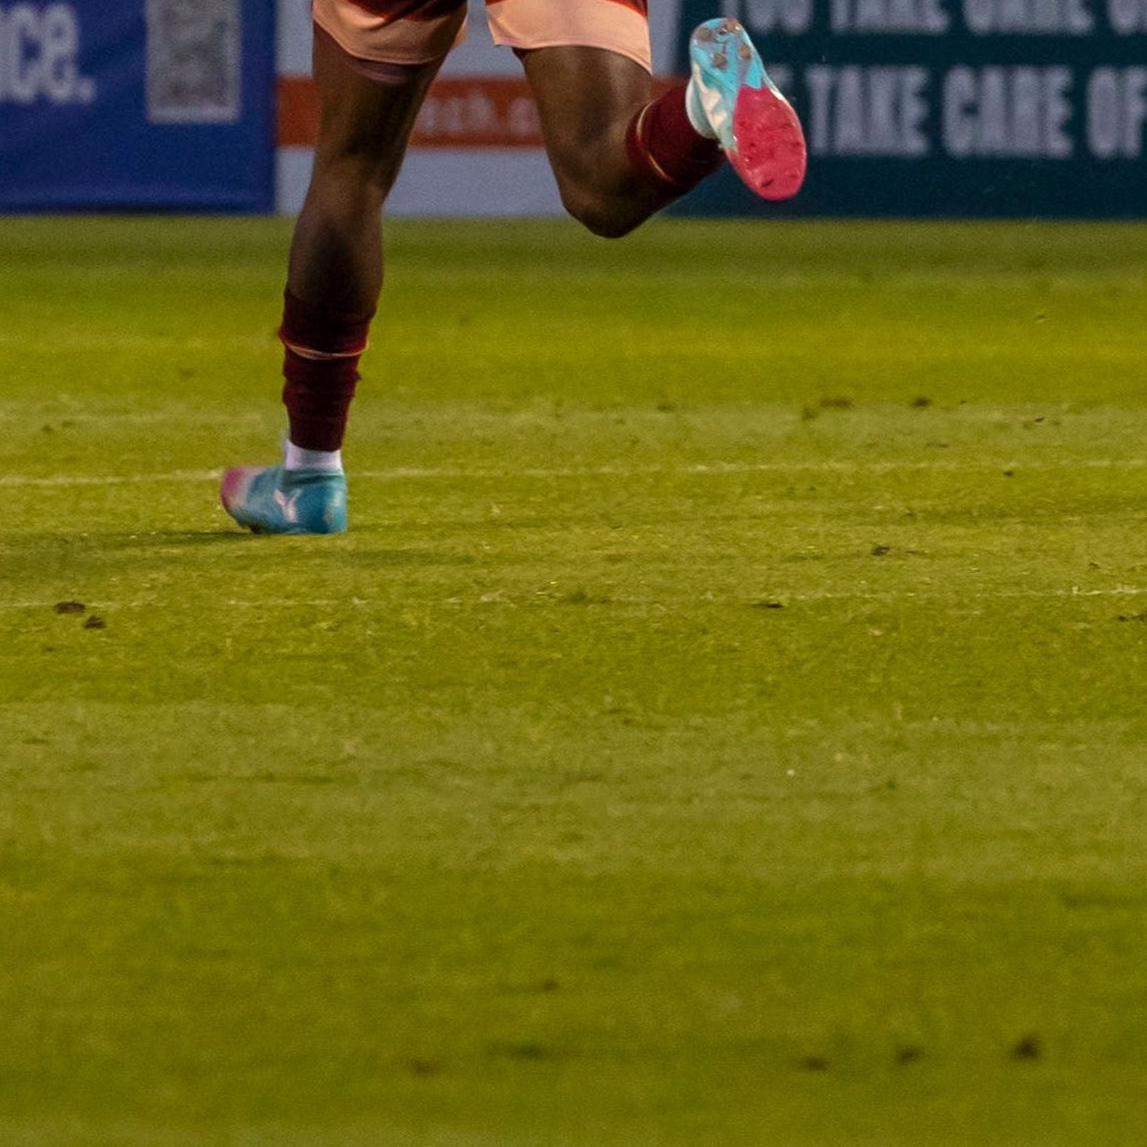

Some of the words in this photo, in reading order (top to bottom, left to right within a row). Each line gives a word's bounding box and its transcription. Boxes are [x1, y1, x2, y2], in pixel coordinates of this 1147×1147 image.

[806, 64, 929, 159] TAKE
[943, 64, 1074, 160] CARE
[1087, 64, 1147, 160] OF
